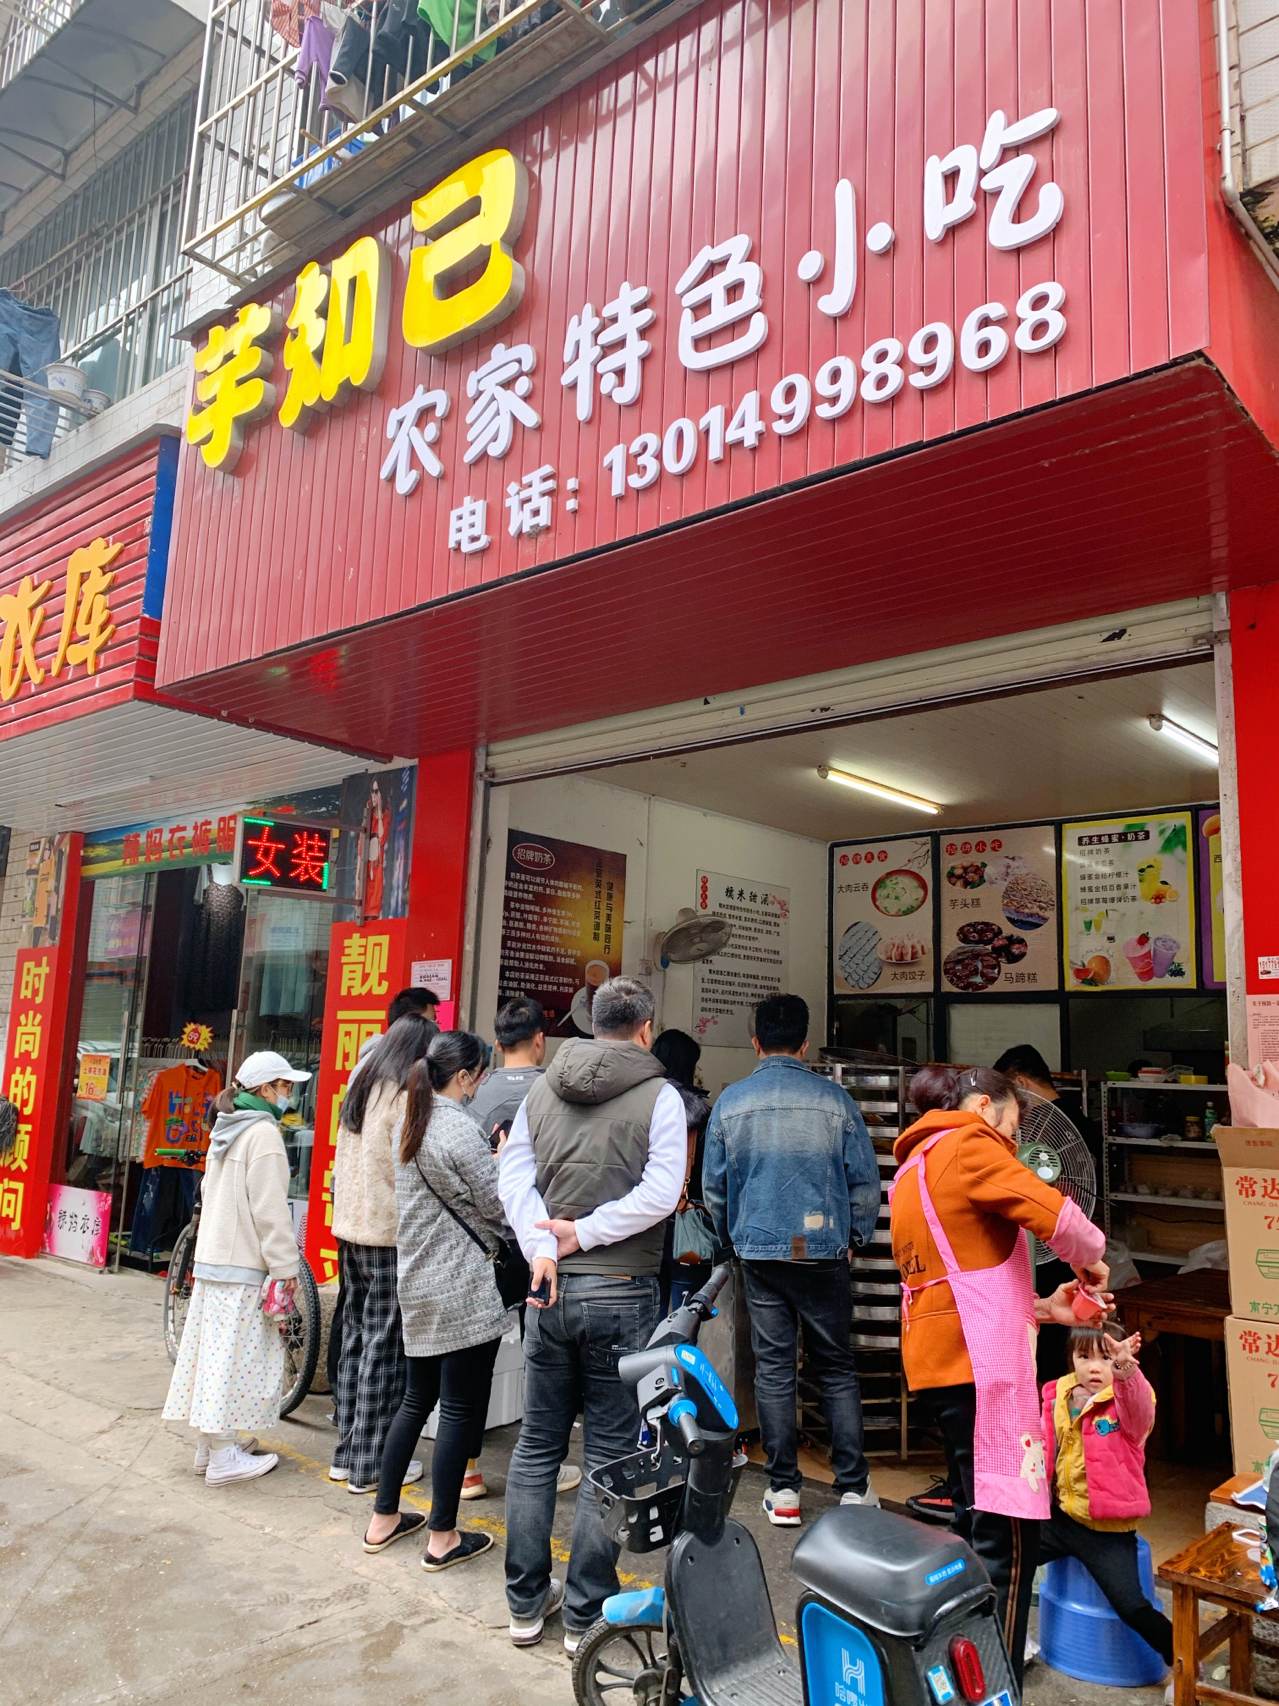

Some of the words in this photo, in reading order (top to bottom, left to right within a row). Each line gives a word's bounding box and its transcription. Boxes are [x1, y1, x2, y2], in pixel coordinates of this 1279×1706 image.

[380, 106, 1065, 495] 农家特色小吃
[246, 826, 327, 883] 女装
[946, 840, 1002, 855] 招牌小吃
[516, 848, 552, 865] 招牌奶茶
[837, 882, 869, 894] 大肉云吞
[949, 898, 981, 909] 芋头糕
[890, 970, 926, 981] 大肉饺子
[1003, 972, 1038, 984] 马蹄糕
[1235, 1176, 1279, 1199] 常达
[1263, 1215, 1279, 1231] 7
[1246, 1356, 1270, 1365] CHANG
